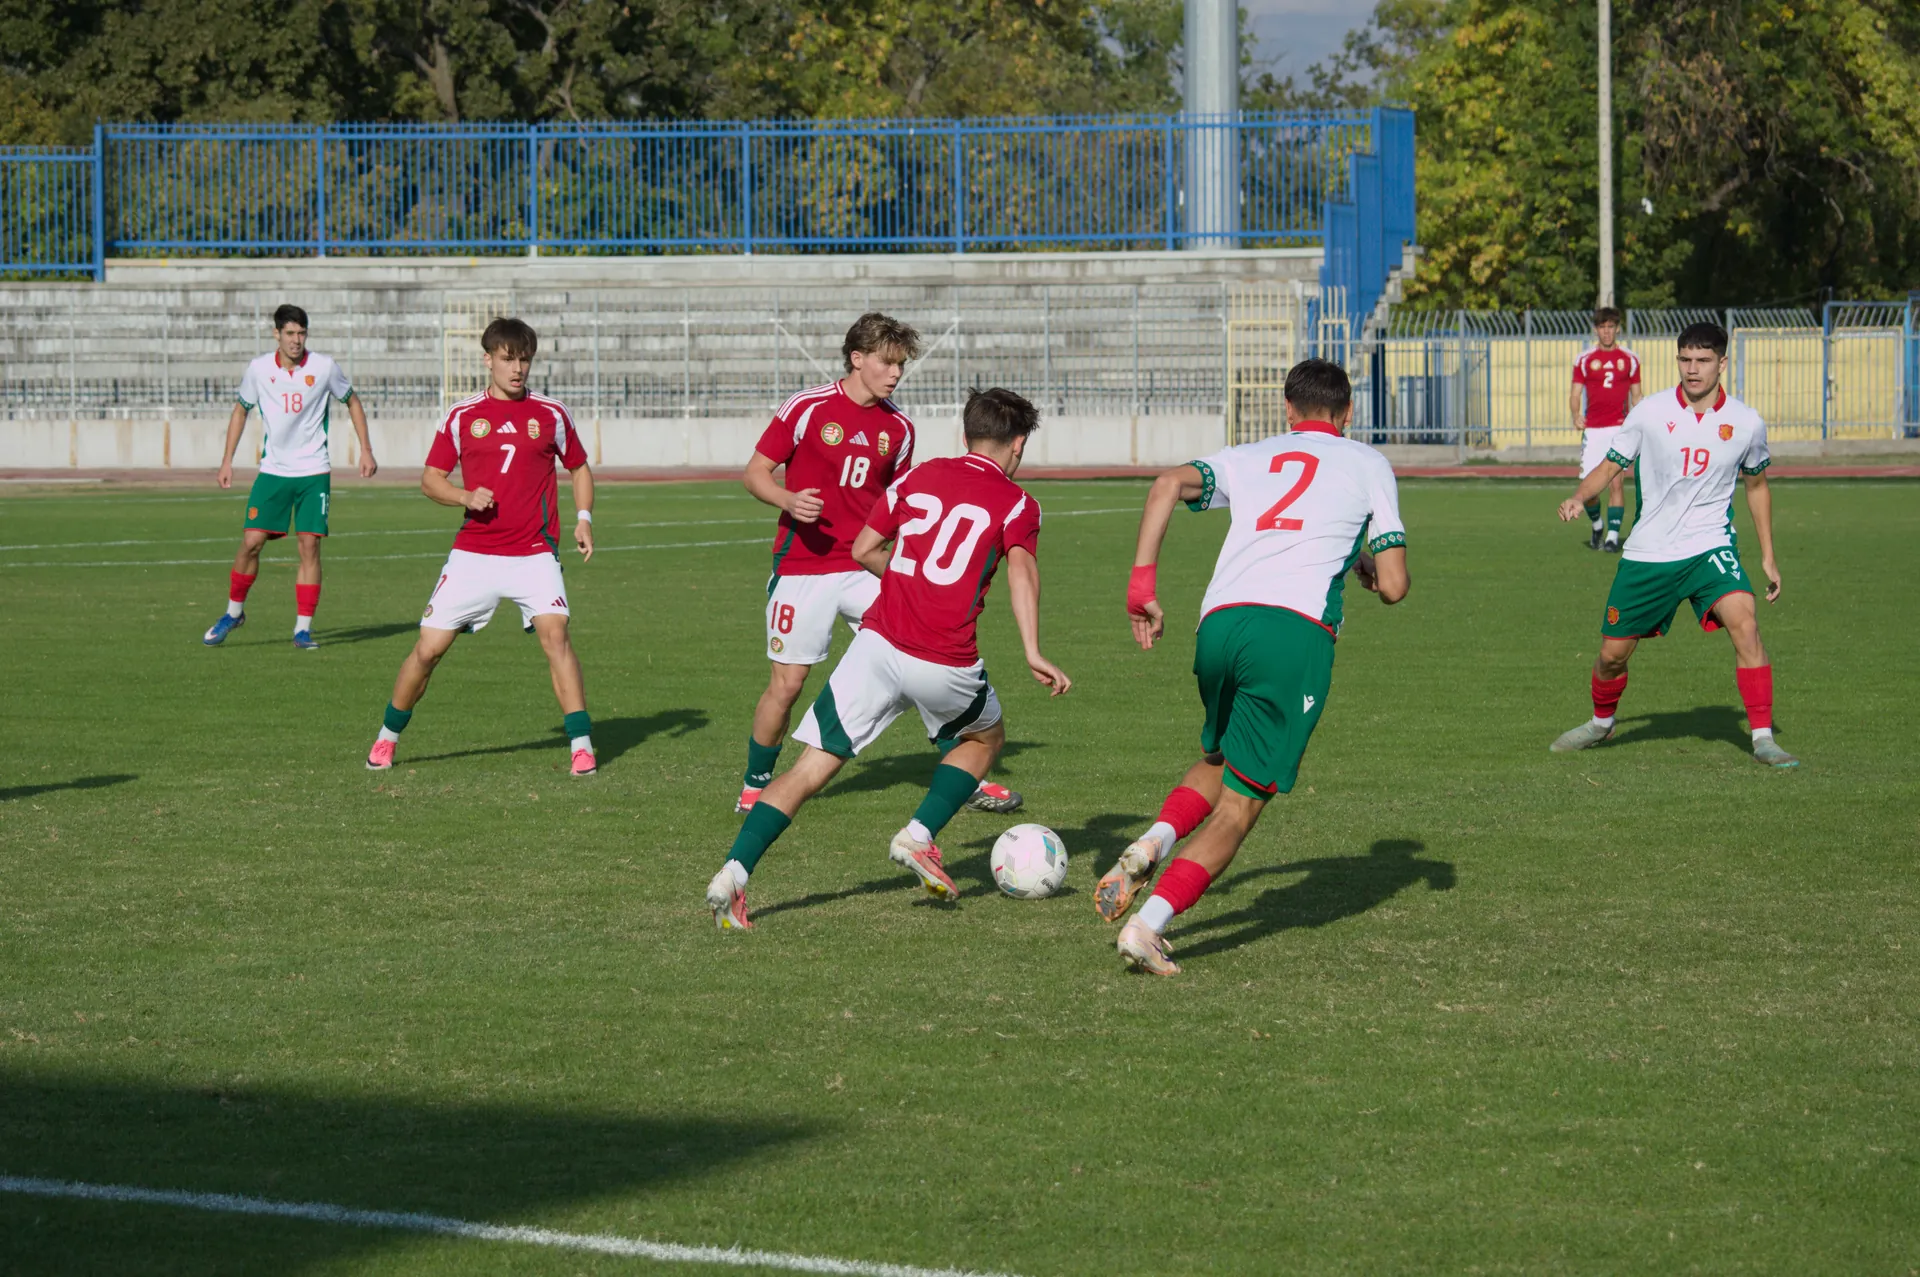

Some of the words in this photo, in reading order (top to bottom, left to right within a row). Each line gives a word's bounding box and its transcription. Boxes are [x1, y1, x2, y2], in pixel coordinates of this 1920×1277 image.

[1603, 372, 1614, 388] 2
[282, 393, 303, 413] 18
[500, 444, 516, 474] 7
[839, 455, 871, 488] 18
[1680, 447, 1710, 477] 19
[1256, 451, 1320, 531] 2
[889, 492, 991, 585] 20
[1708, 550, 1739, 574] 19
[771, 601, 795, 634] 18
